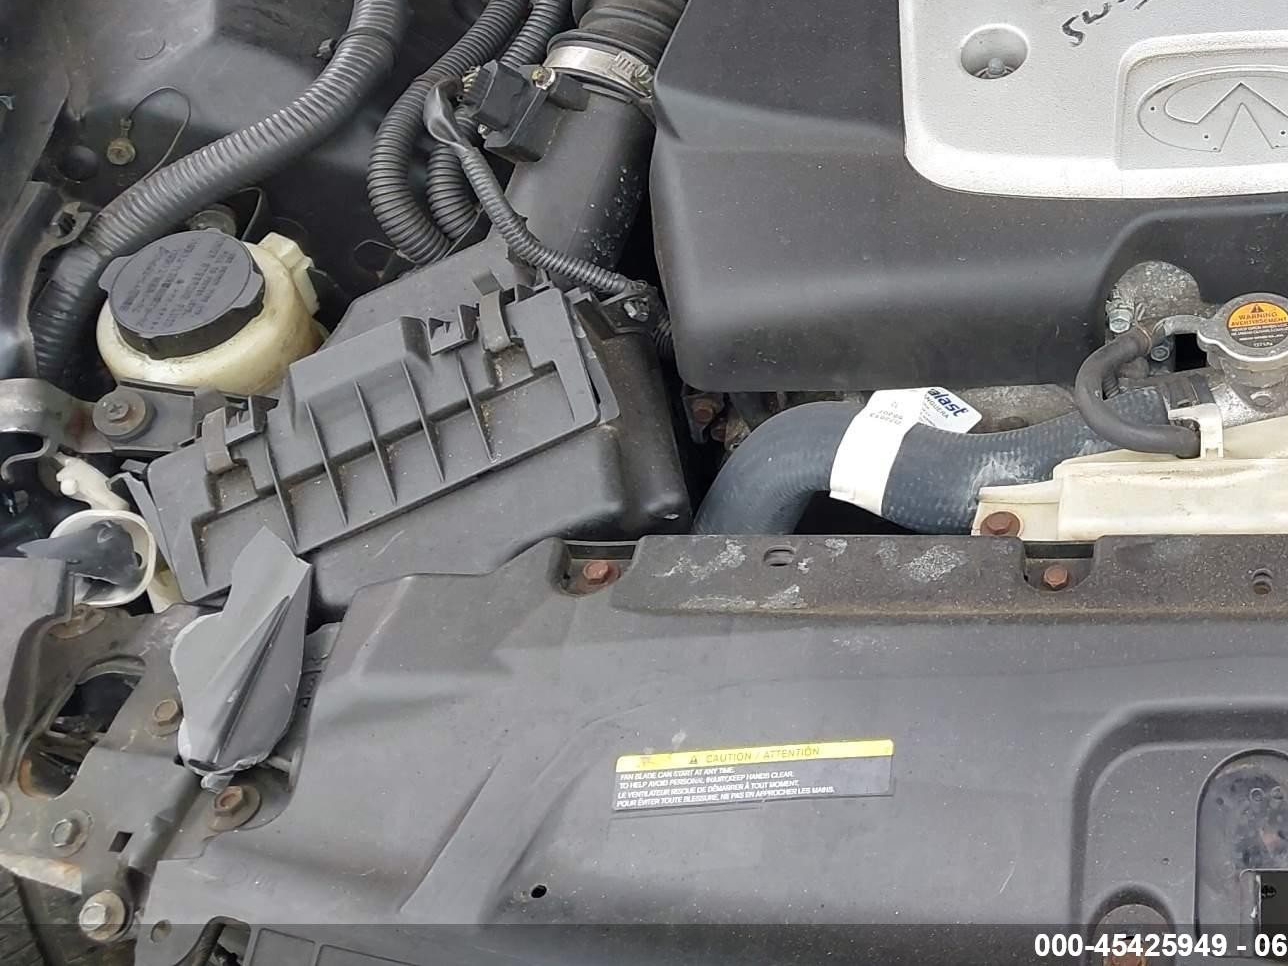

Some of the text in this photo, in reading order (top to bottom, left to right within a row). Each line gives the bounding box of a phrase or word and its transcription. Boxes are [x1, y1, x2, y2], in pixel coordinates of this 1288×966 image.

[1238, 312, 1278, 320] WARNING
[706, 752, 752, 763] CAUTION
[763, 746, 820, 759] ATTENTION
[620, 773, 634, 781] FAN
[619, 782, 630, 790] TO
